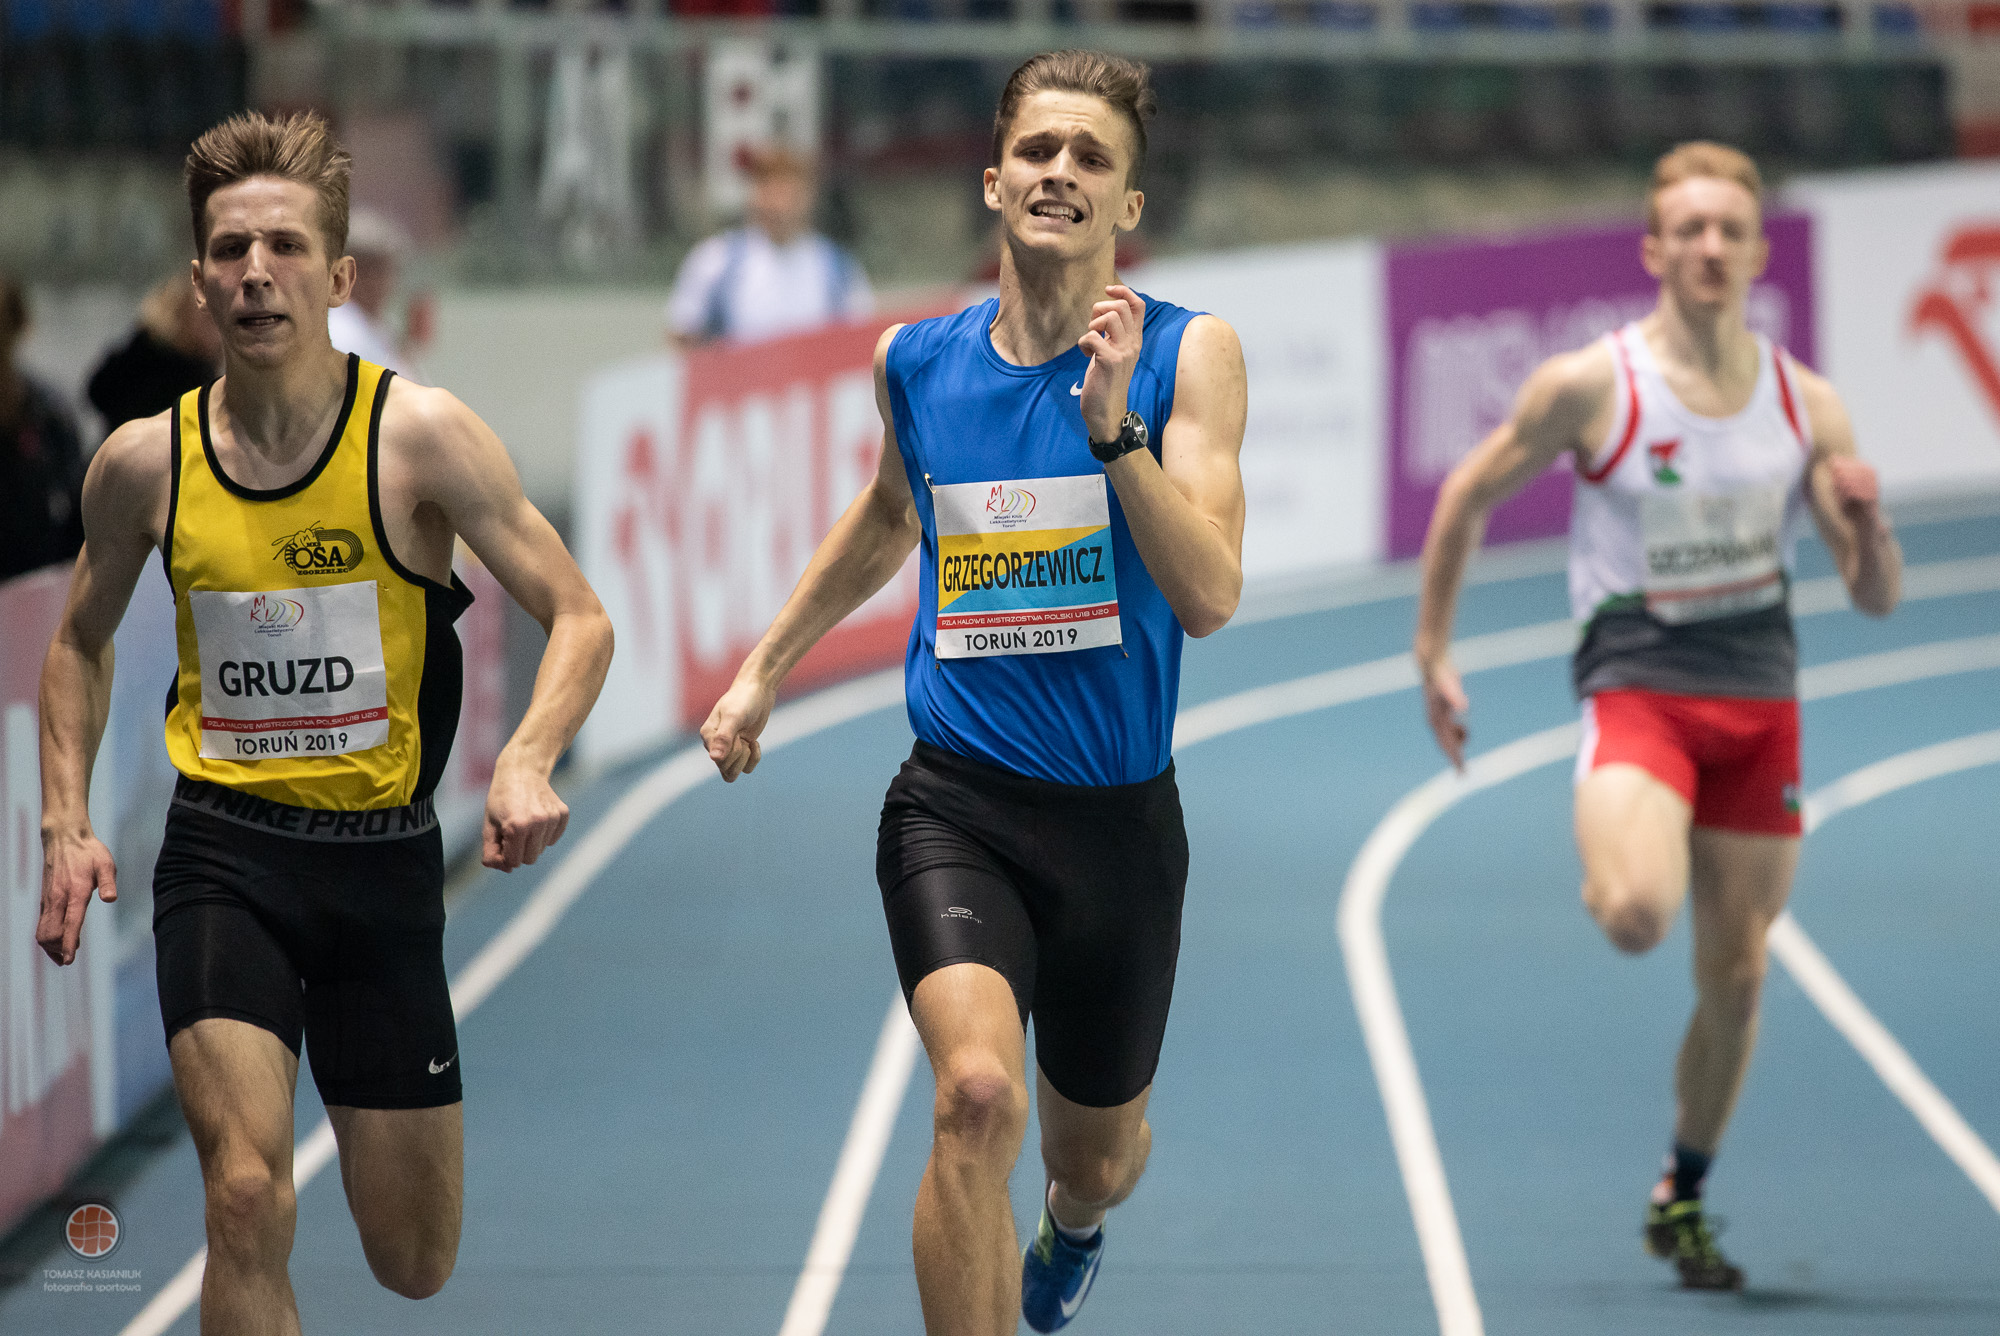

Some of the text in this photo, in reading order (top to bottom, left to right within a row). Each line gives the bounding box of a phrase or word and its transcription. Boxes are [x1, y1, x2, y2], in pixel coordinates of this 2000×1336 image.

[293, 546, 346, 569] OSA
[943, 546, 1106, 593] GRZEGORZEWICZ
[957, 617, 986, 625] HALOWE
[986, 614, 1043, 624] MISTRZOSTWA
[1044, 612, 1074, 621] POLSKI
[965, 626, 1078, 651] TORUŃ 2019
[218, 655, 355, 697] GRUZD
[255, 719, 315, 730] MISTRZOSTWA
[316, 717, 345, 727] POLSKI
[361, 711, 379, 720] U20
[235, 731, 348, 755] TORUŃ 2019
[212, 788, 300, 831] NIKE
[305, 809, 390, 837] PRO
[399, 797, 436, 832] NIK
